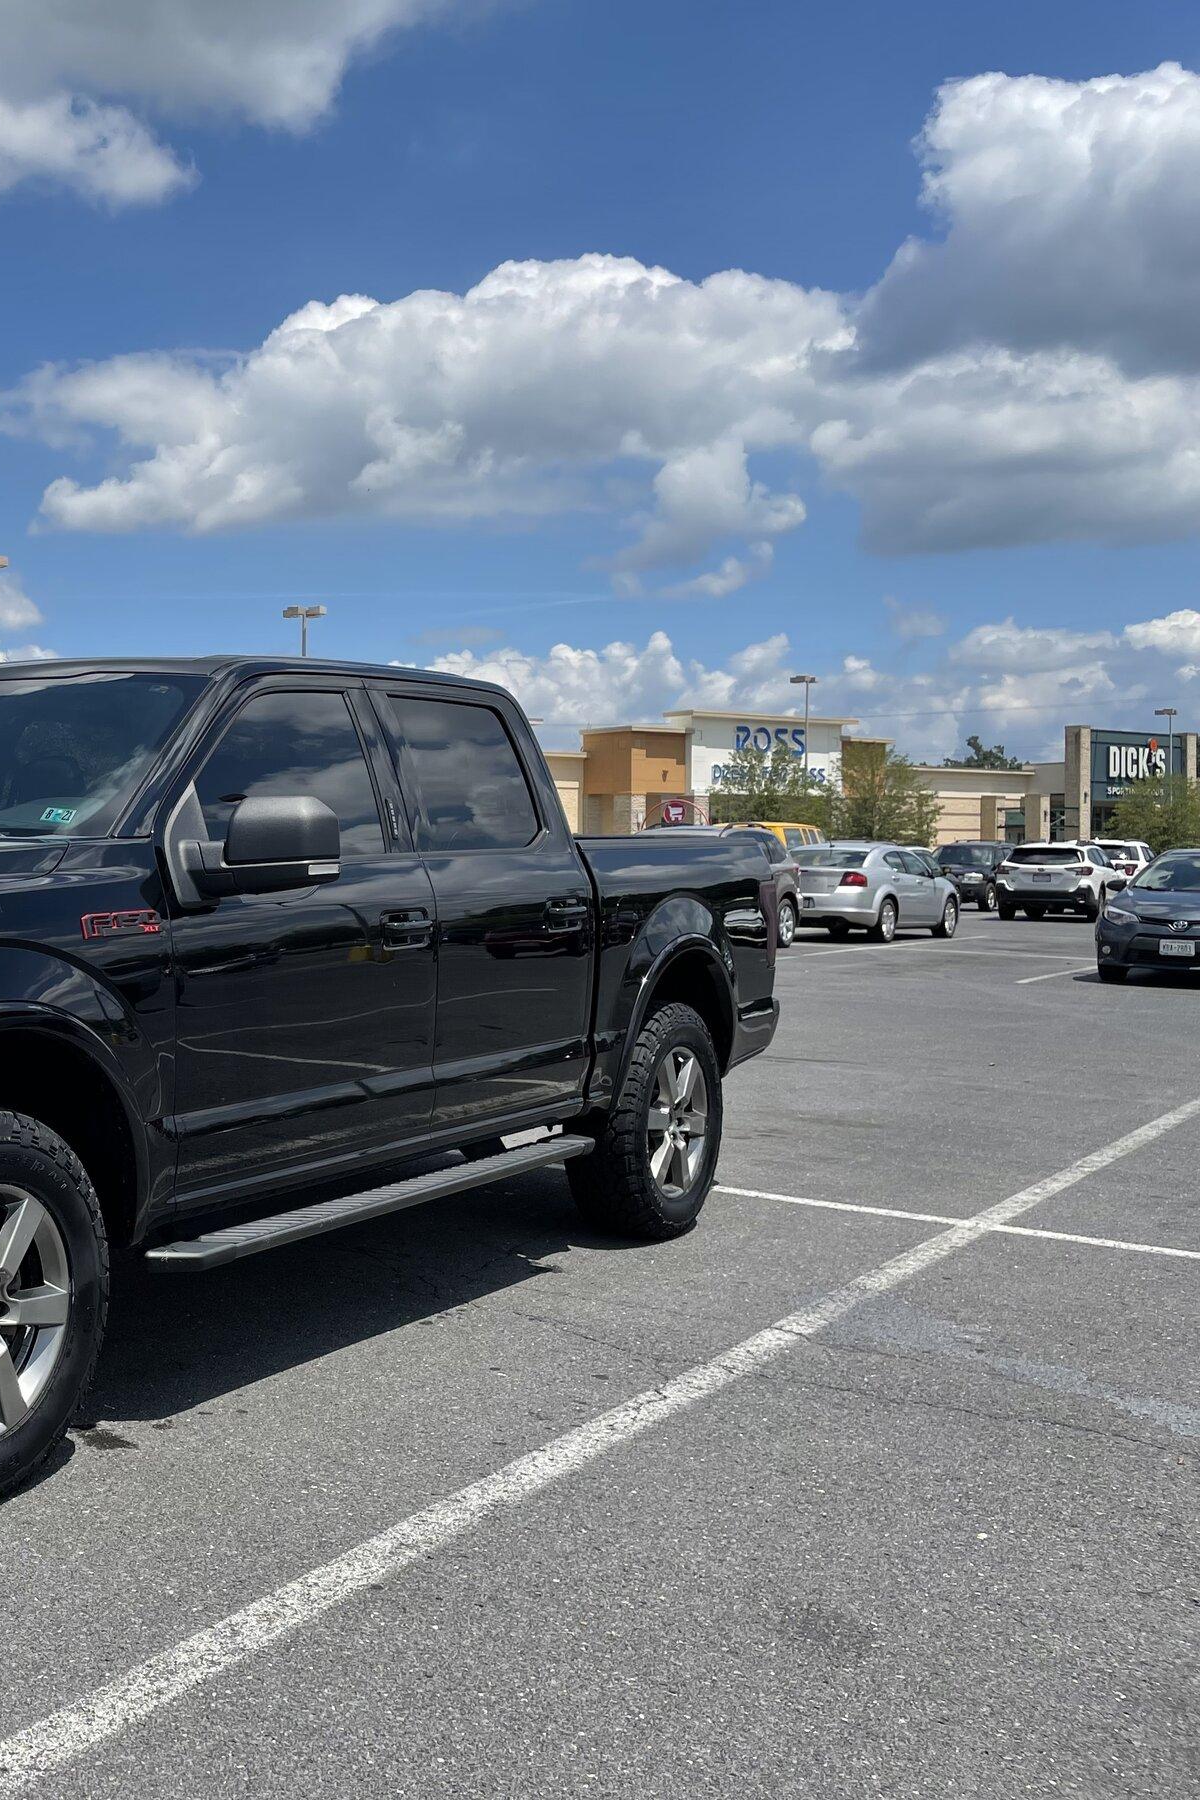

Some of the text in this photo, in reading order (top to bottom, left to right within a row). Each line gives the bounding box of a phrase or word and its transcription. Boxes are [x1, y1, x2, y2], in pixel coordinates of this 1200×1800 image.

[735, 726, 805, 756] ROSS
[1108, 745, 1166, 779] DICK'S
[143, 924, 160, 933] XLT
